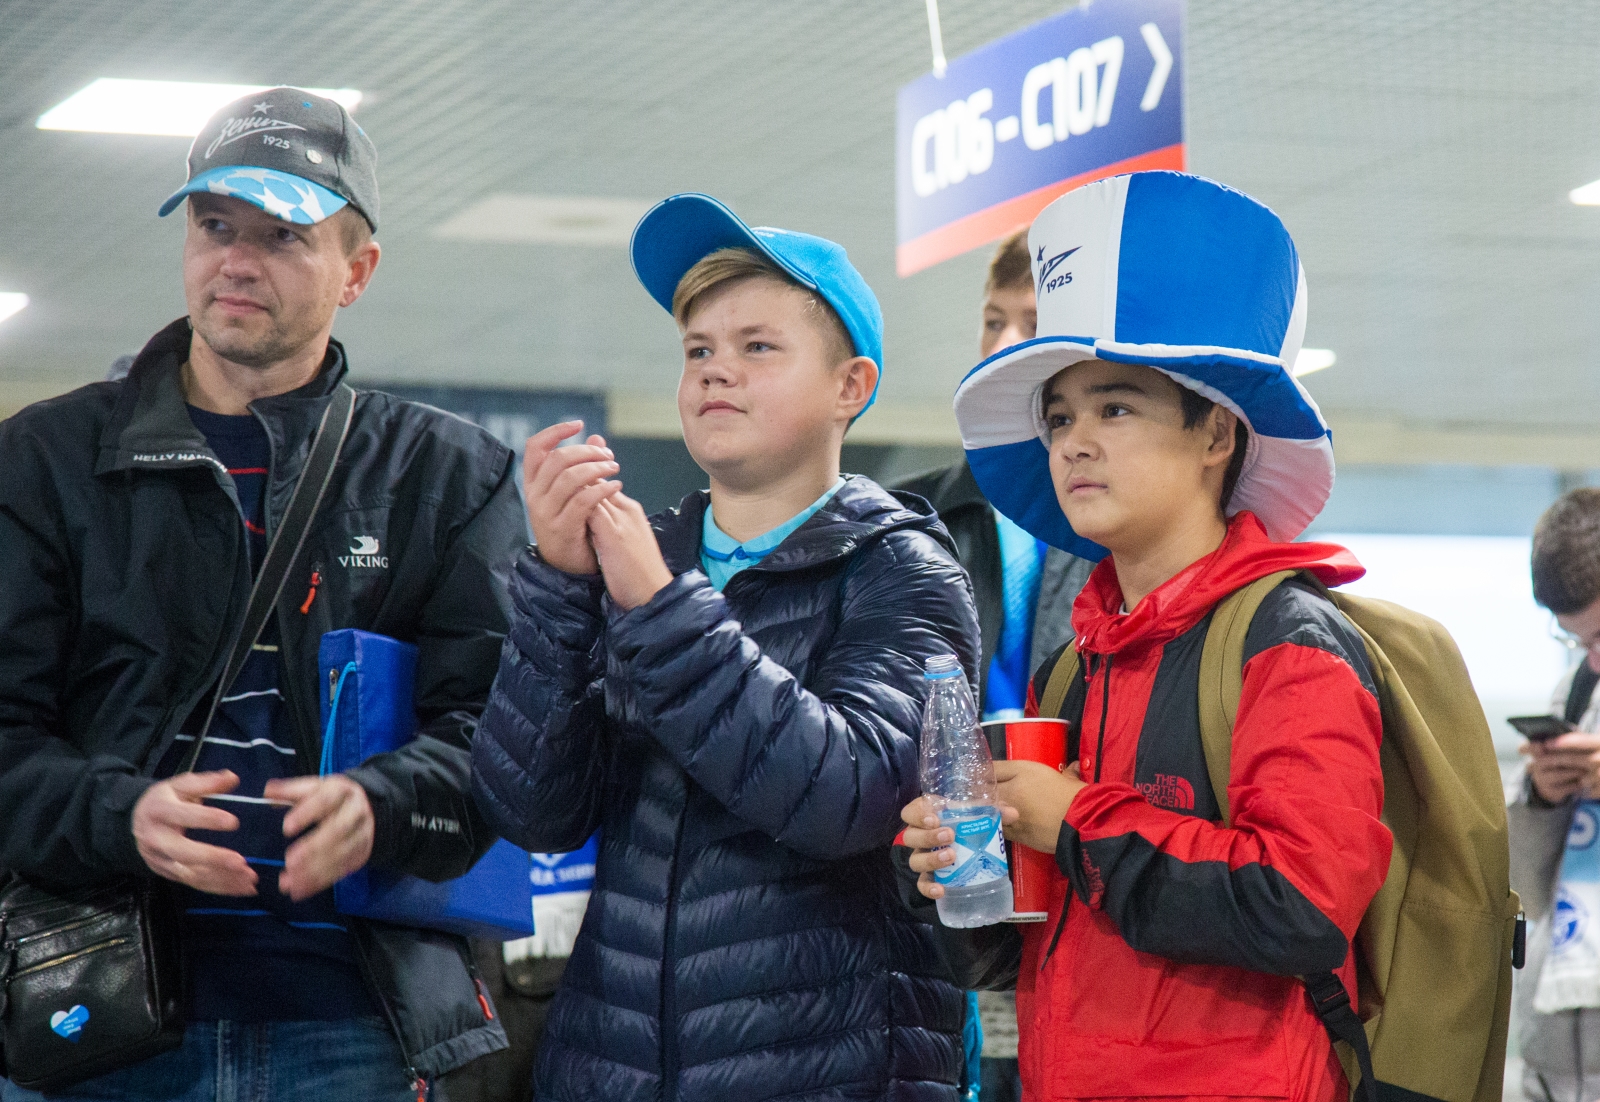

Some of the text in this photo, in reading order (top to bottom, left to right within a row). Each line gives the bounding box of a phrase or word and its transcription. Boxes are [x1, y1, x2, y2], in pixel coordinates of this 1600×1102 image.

[262, 135, 291, 150] 1925
[1046, 271, 1073, 294] 1925
[133, 453, 175, 462] HELLY
[338, 555, 389, 569] VIKING
[1154, 773, 1176, 786] THE
[1135, 782, 1175, 797] NORTH
[1145, 793, 1174, 808] FACE
